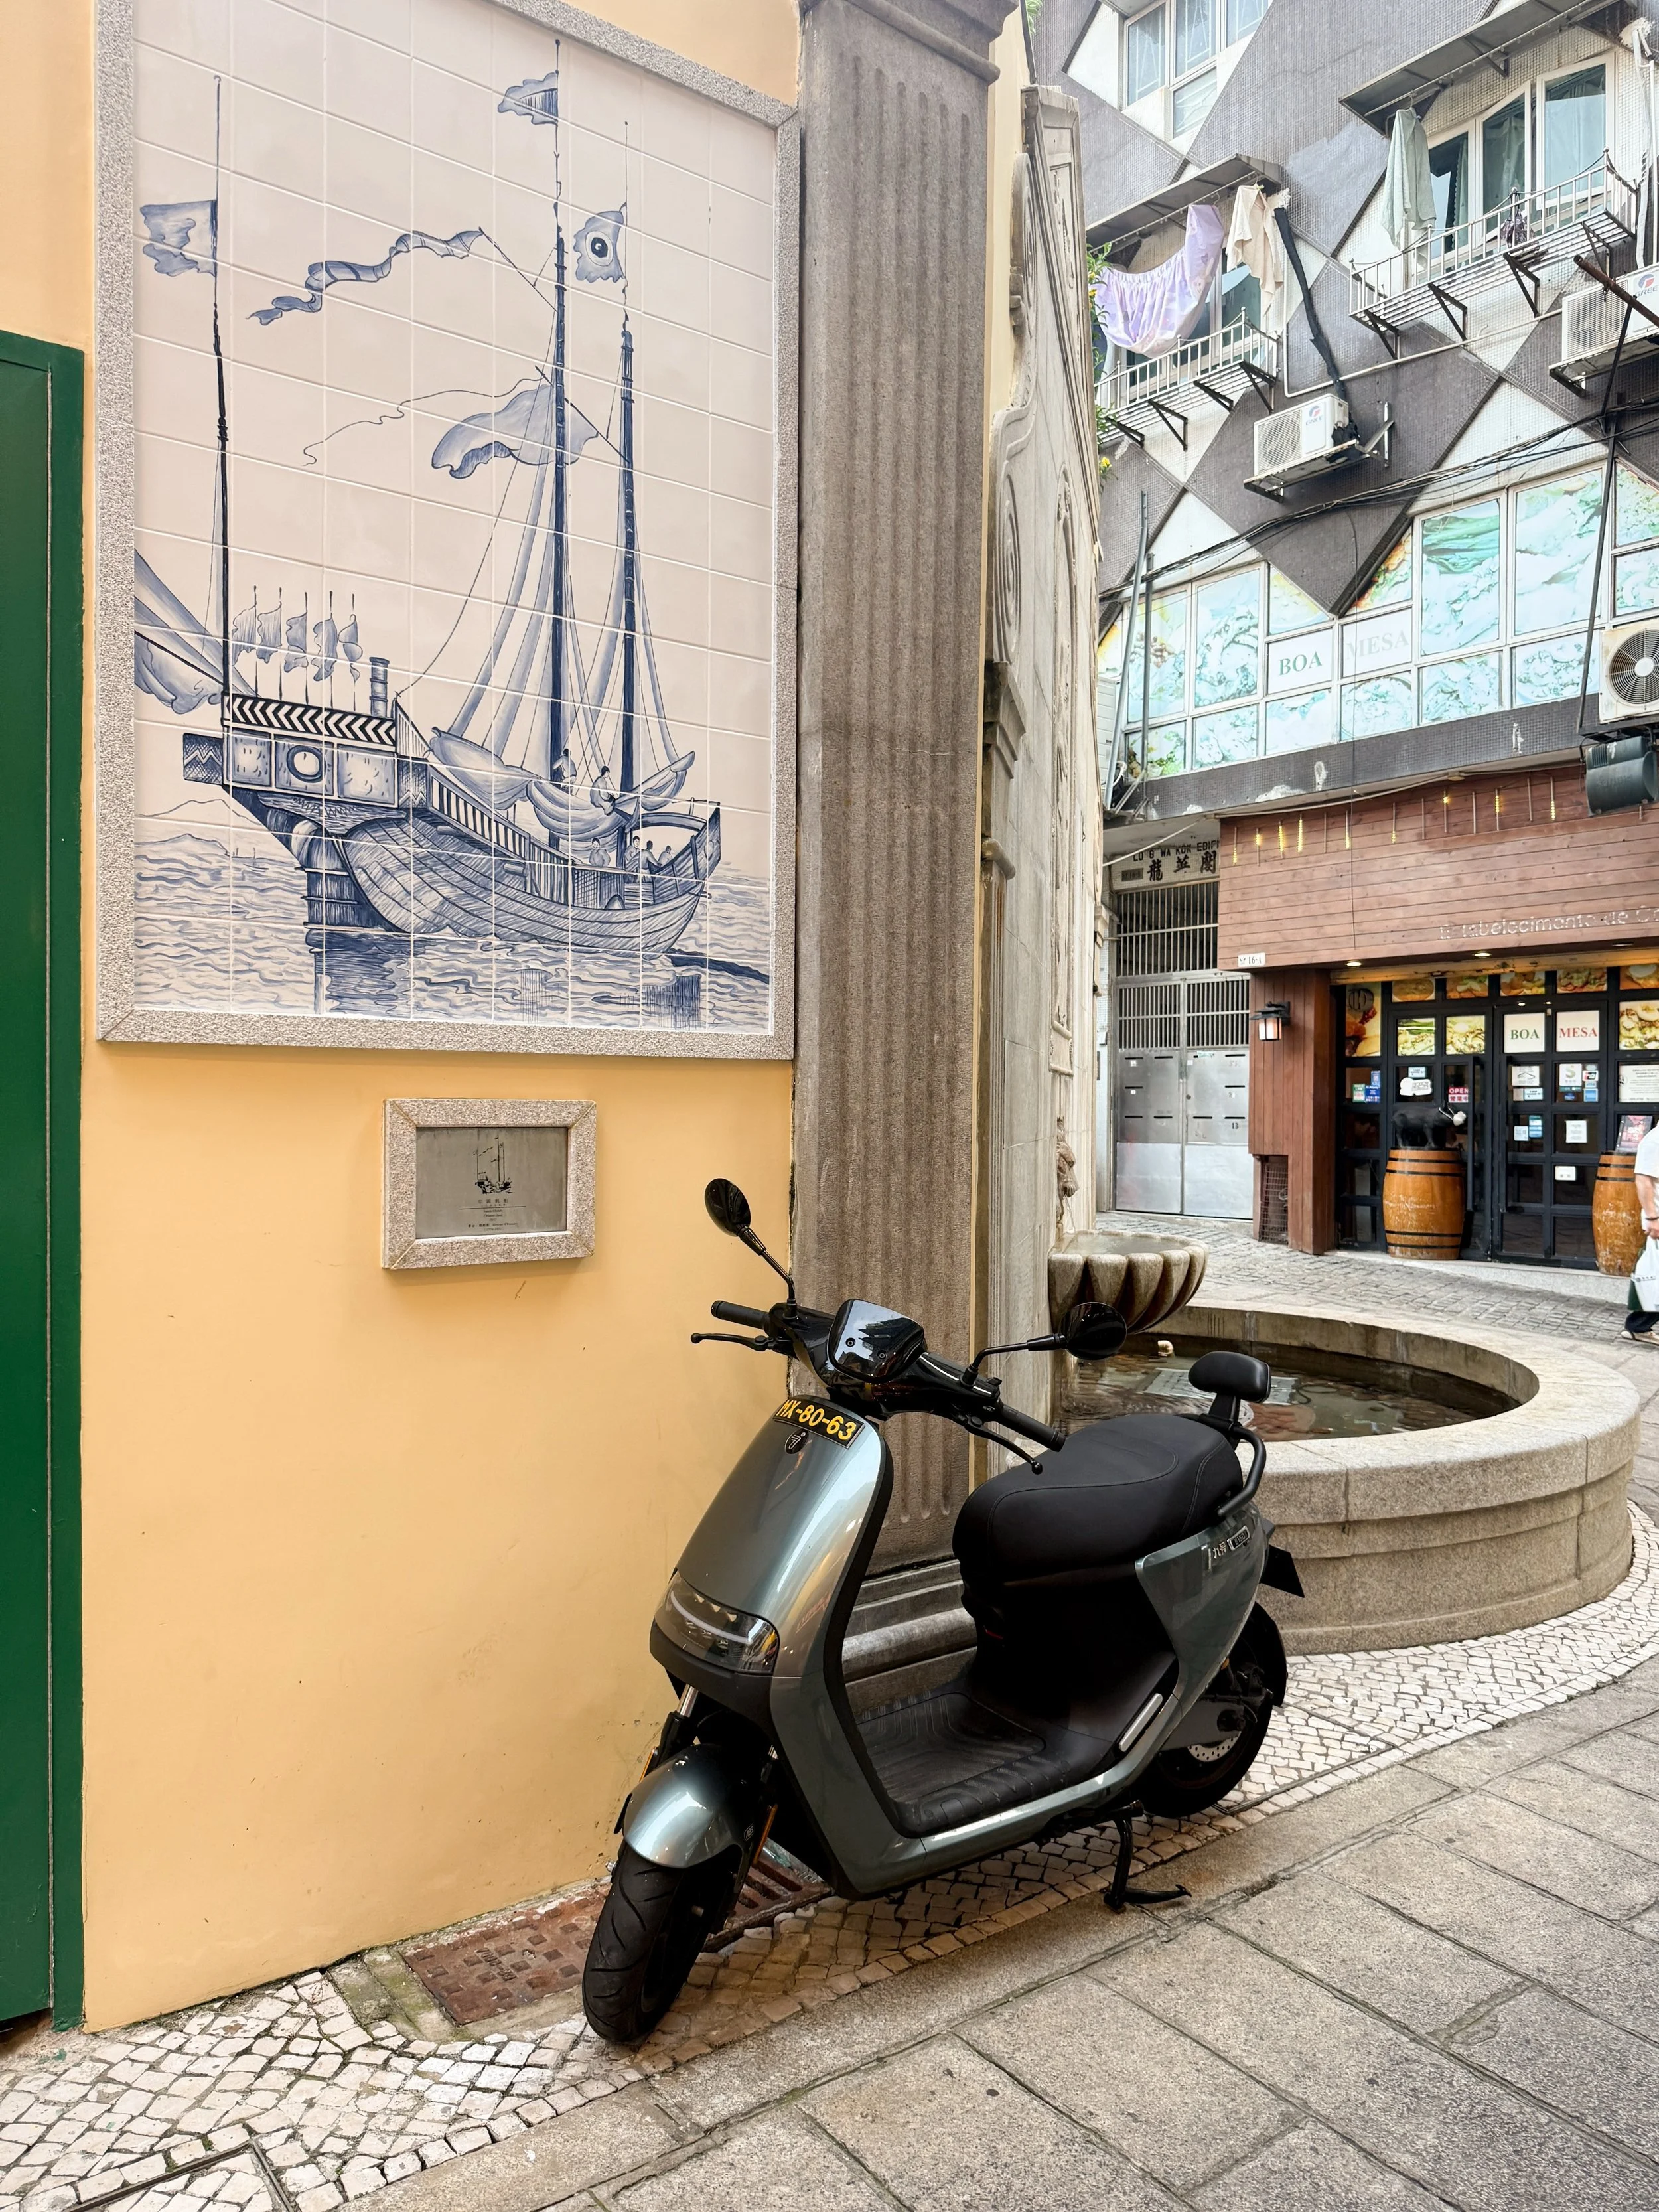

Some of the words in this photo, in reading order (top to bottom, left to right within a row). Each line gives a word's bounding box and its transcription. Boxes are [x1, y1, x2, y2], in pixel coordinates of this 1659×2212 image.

[1635, 286, 1658, 297] GREE
[1279, 651, 1323, 676] BOA
[1346, 630, 1409, 660] MESA
[1510, 1029, 1540, 1040] BOA
[1559, 1027, 1598, 1039] MESA
[776, 1399, 857, 1441] MX-80-63
